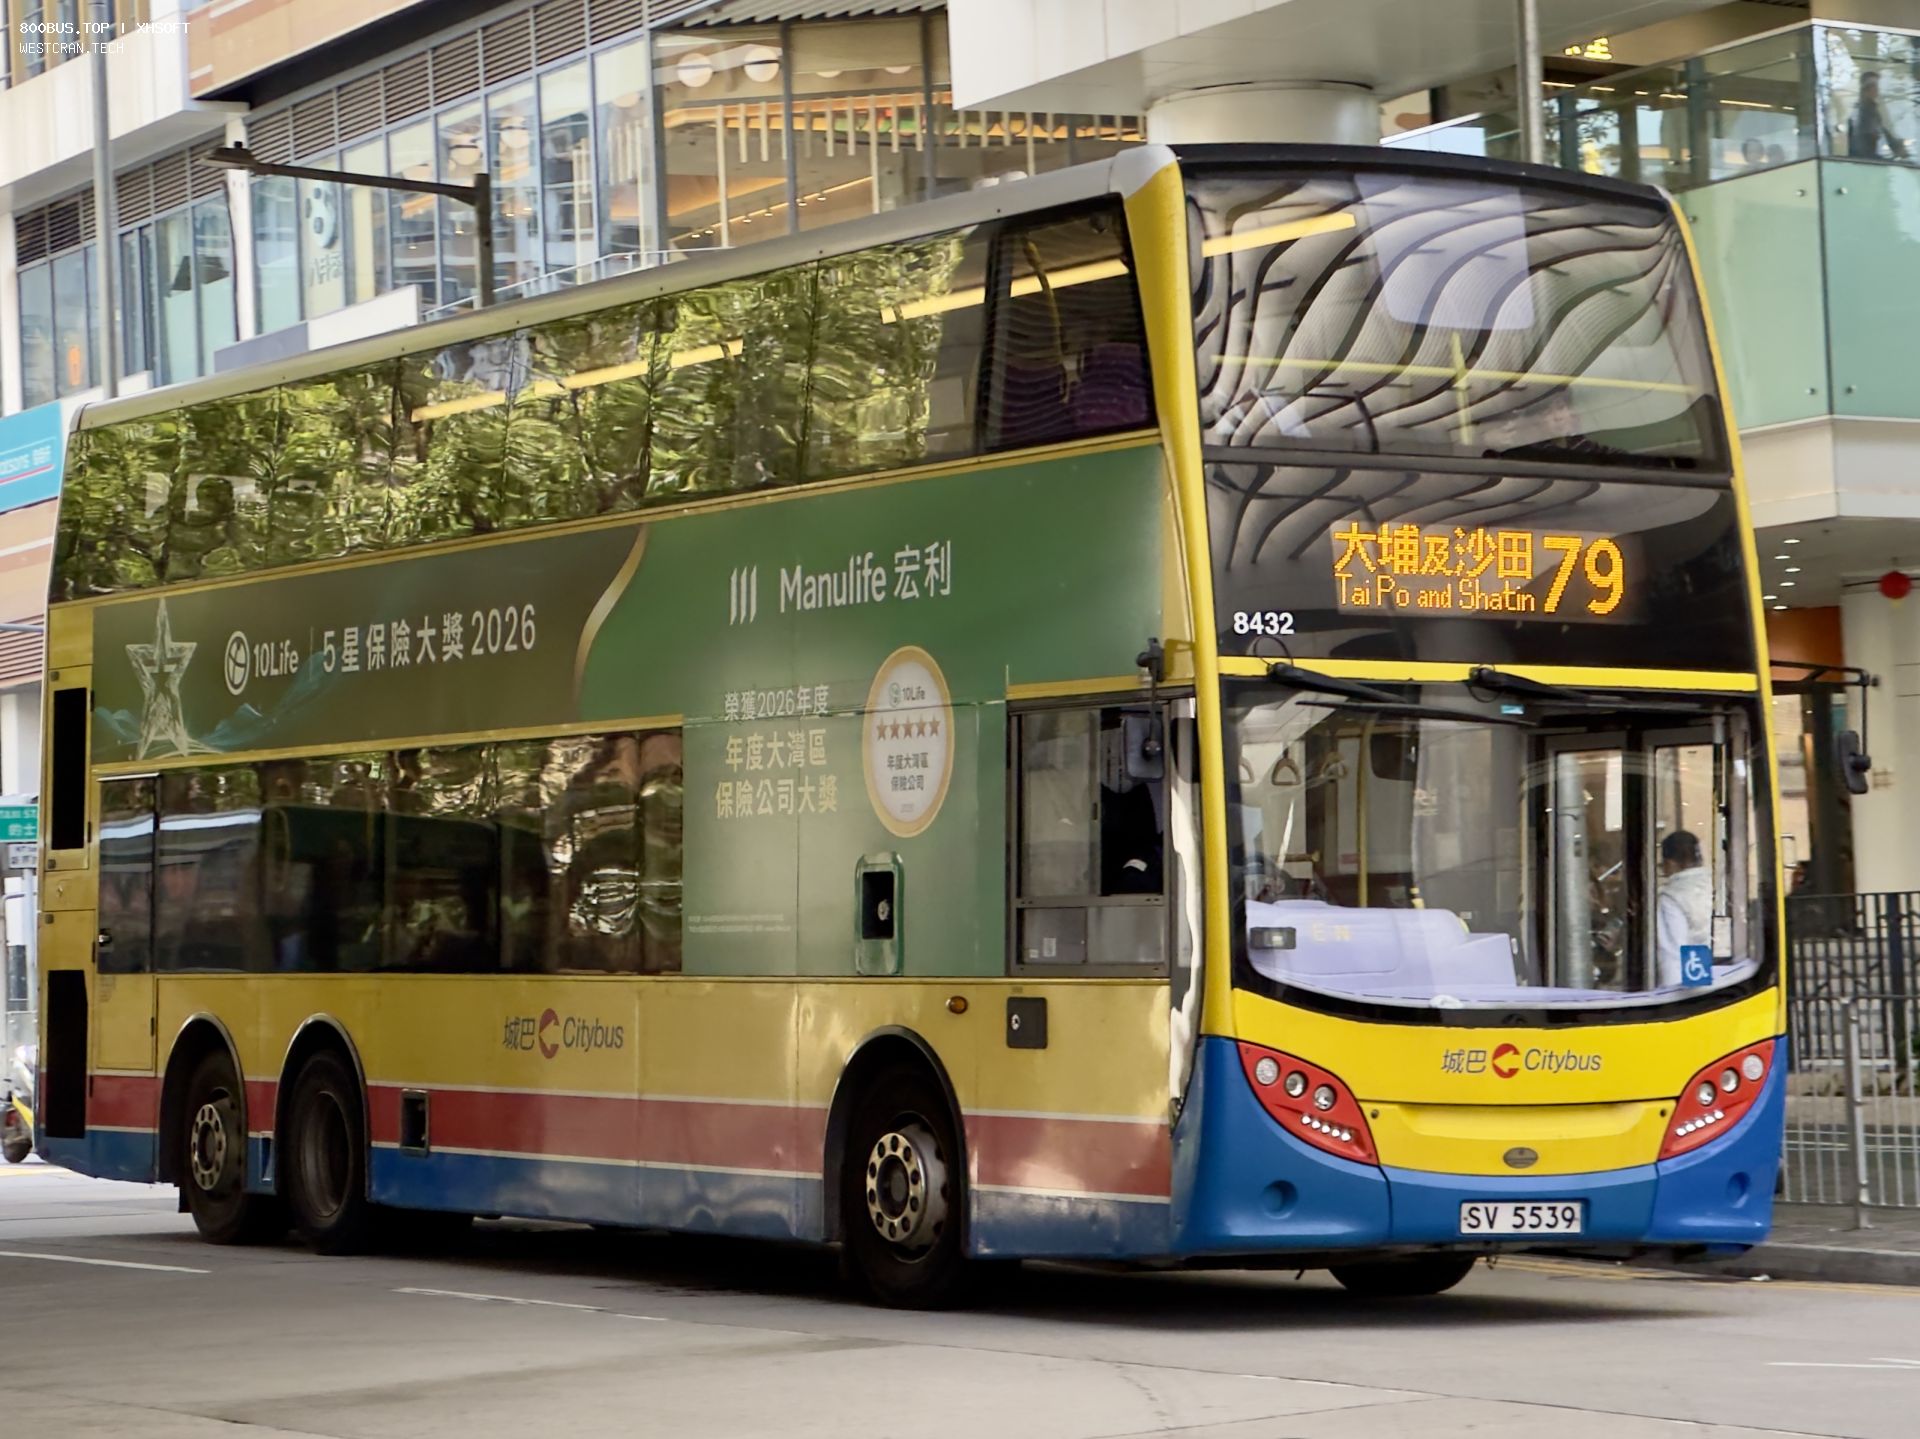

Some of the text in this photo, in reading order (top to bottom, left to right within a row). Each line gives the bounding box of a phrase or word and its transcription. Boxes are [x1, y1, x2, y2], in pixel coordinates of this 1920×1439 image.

[1333, 522, 1533, 579] 大埔及沙田
[780, 540, 951, 613] Manulife 宏利
[1334, 573, 1535, 612] Tai Po and Shatin
[1542, 535, 1624, 615] 79
[1233, 612, 1294, 635] 8432
[253, 639, 299, 678] 10Life
[724, 684, 829, 721] 榮獲2026年度
[725, 728, 827, 772] 年度大灣區
[716, 774, 838, 819] 保險公司大獎
[502, 1016, 624, 1052] 城巴 Citybus
[1441, 1049, 1602, 1073] 城巴 Citybus
[1466, 1206, 1576, 1230] SV 5539
